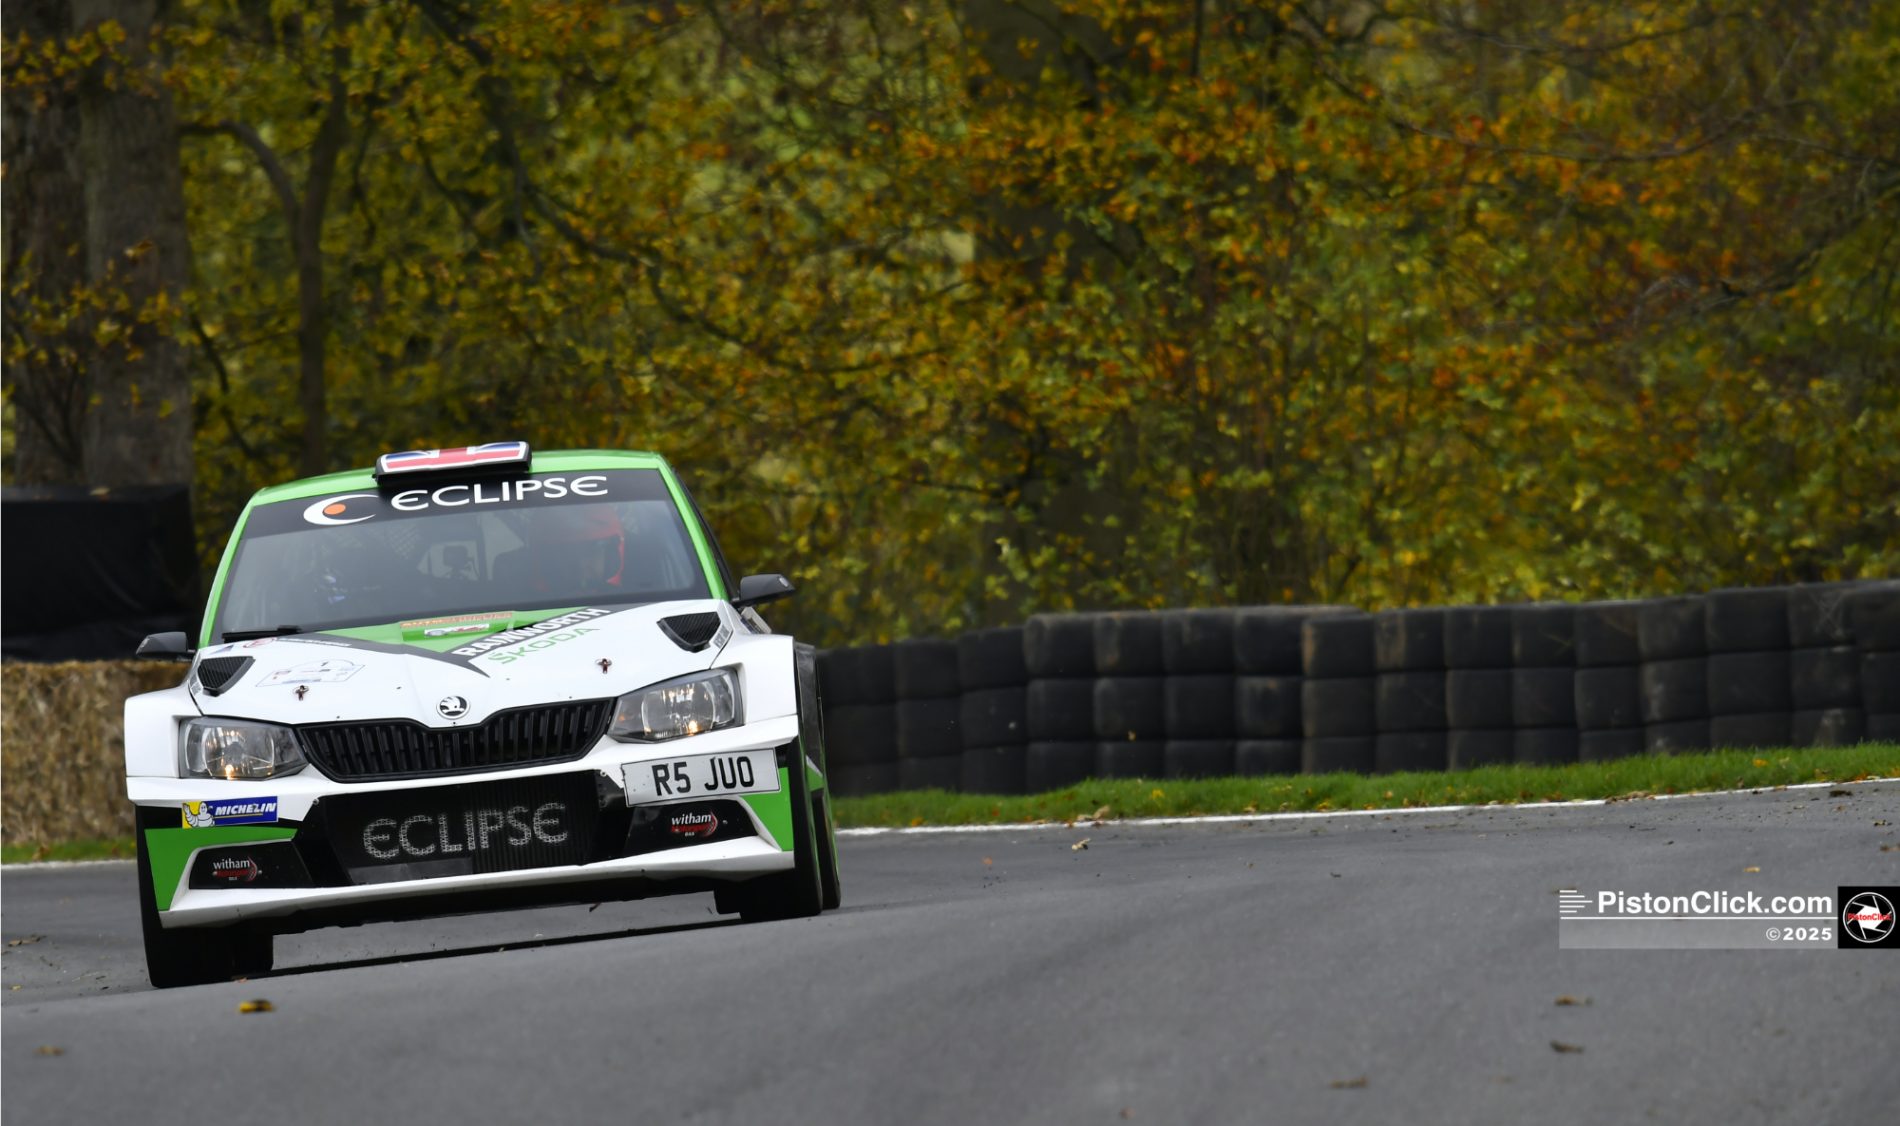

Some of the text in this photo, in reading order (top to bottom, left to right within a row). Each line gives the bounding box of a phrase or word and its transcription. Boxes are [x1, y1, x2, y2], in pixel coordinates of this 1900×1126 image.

[391, 476, 608, 511] ECLIPSE
[452, 608, 611, 656] RAINWORTH
[652, 756, 755, 796] R5 JUO
[215, 803, 277, 816] MICHELIN
[671, 812, 712, 825] witham
[363, 802, 568, 858] ECLIPSE
[213, 858, 250, 870] witham
